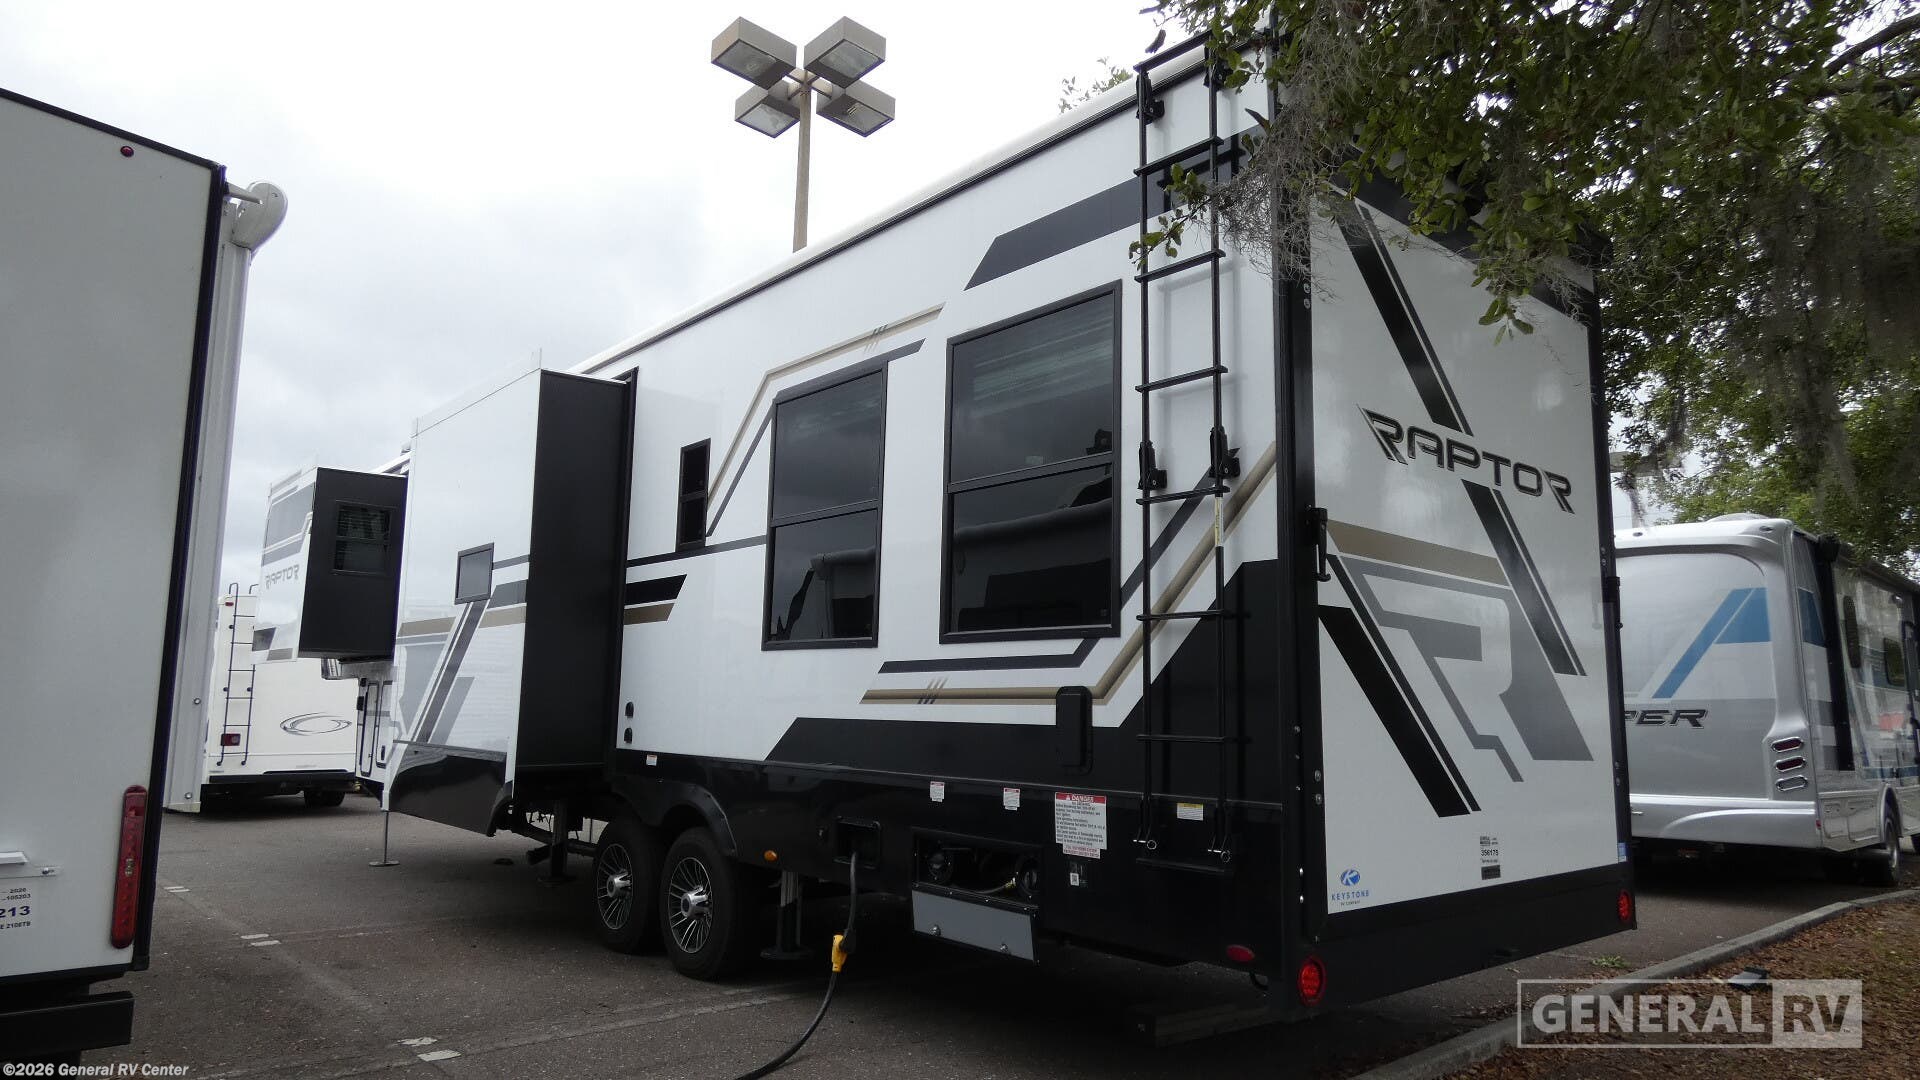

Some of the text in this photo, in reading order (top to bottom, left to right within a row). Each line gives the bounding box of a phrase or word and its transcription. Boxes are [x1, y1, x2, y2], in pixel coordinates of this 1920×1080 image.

[1356, 403, 1575, 514] RAPTOR
[265, 564, 299, 589] RAPTOR
[1331, 890, 1369, 901] KEYSTONE
